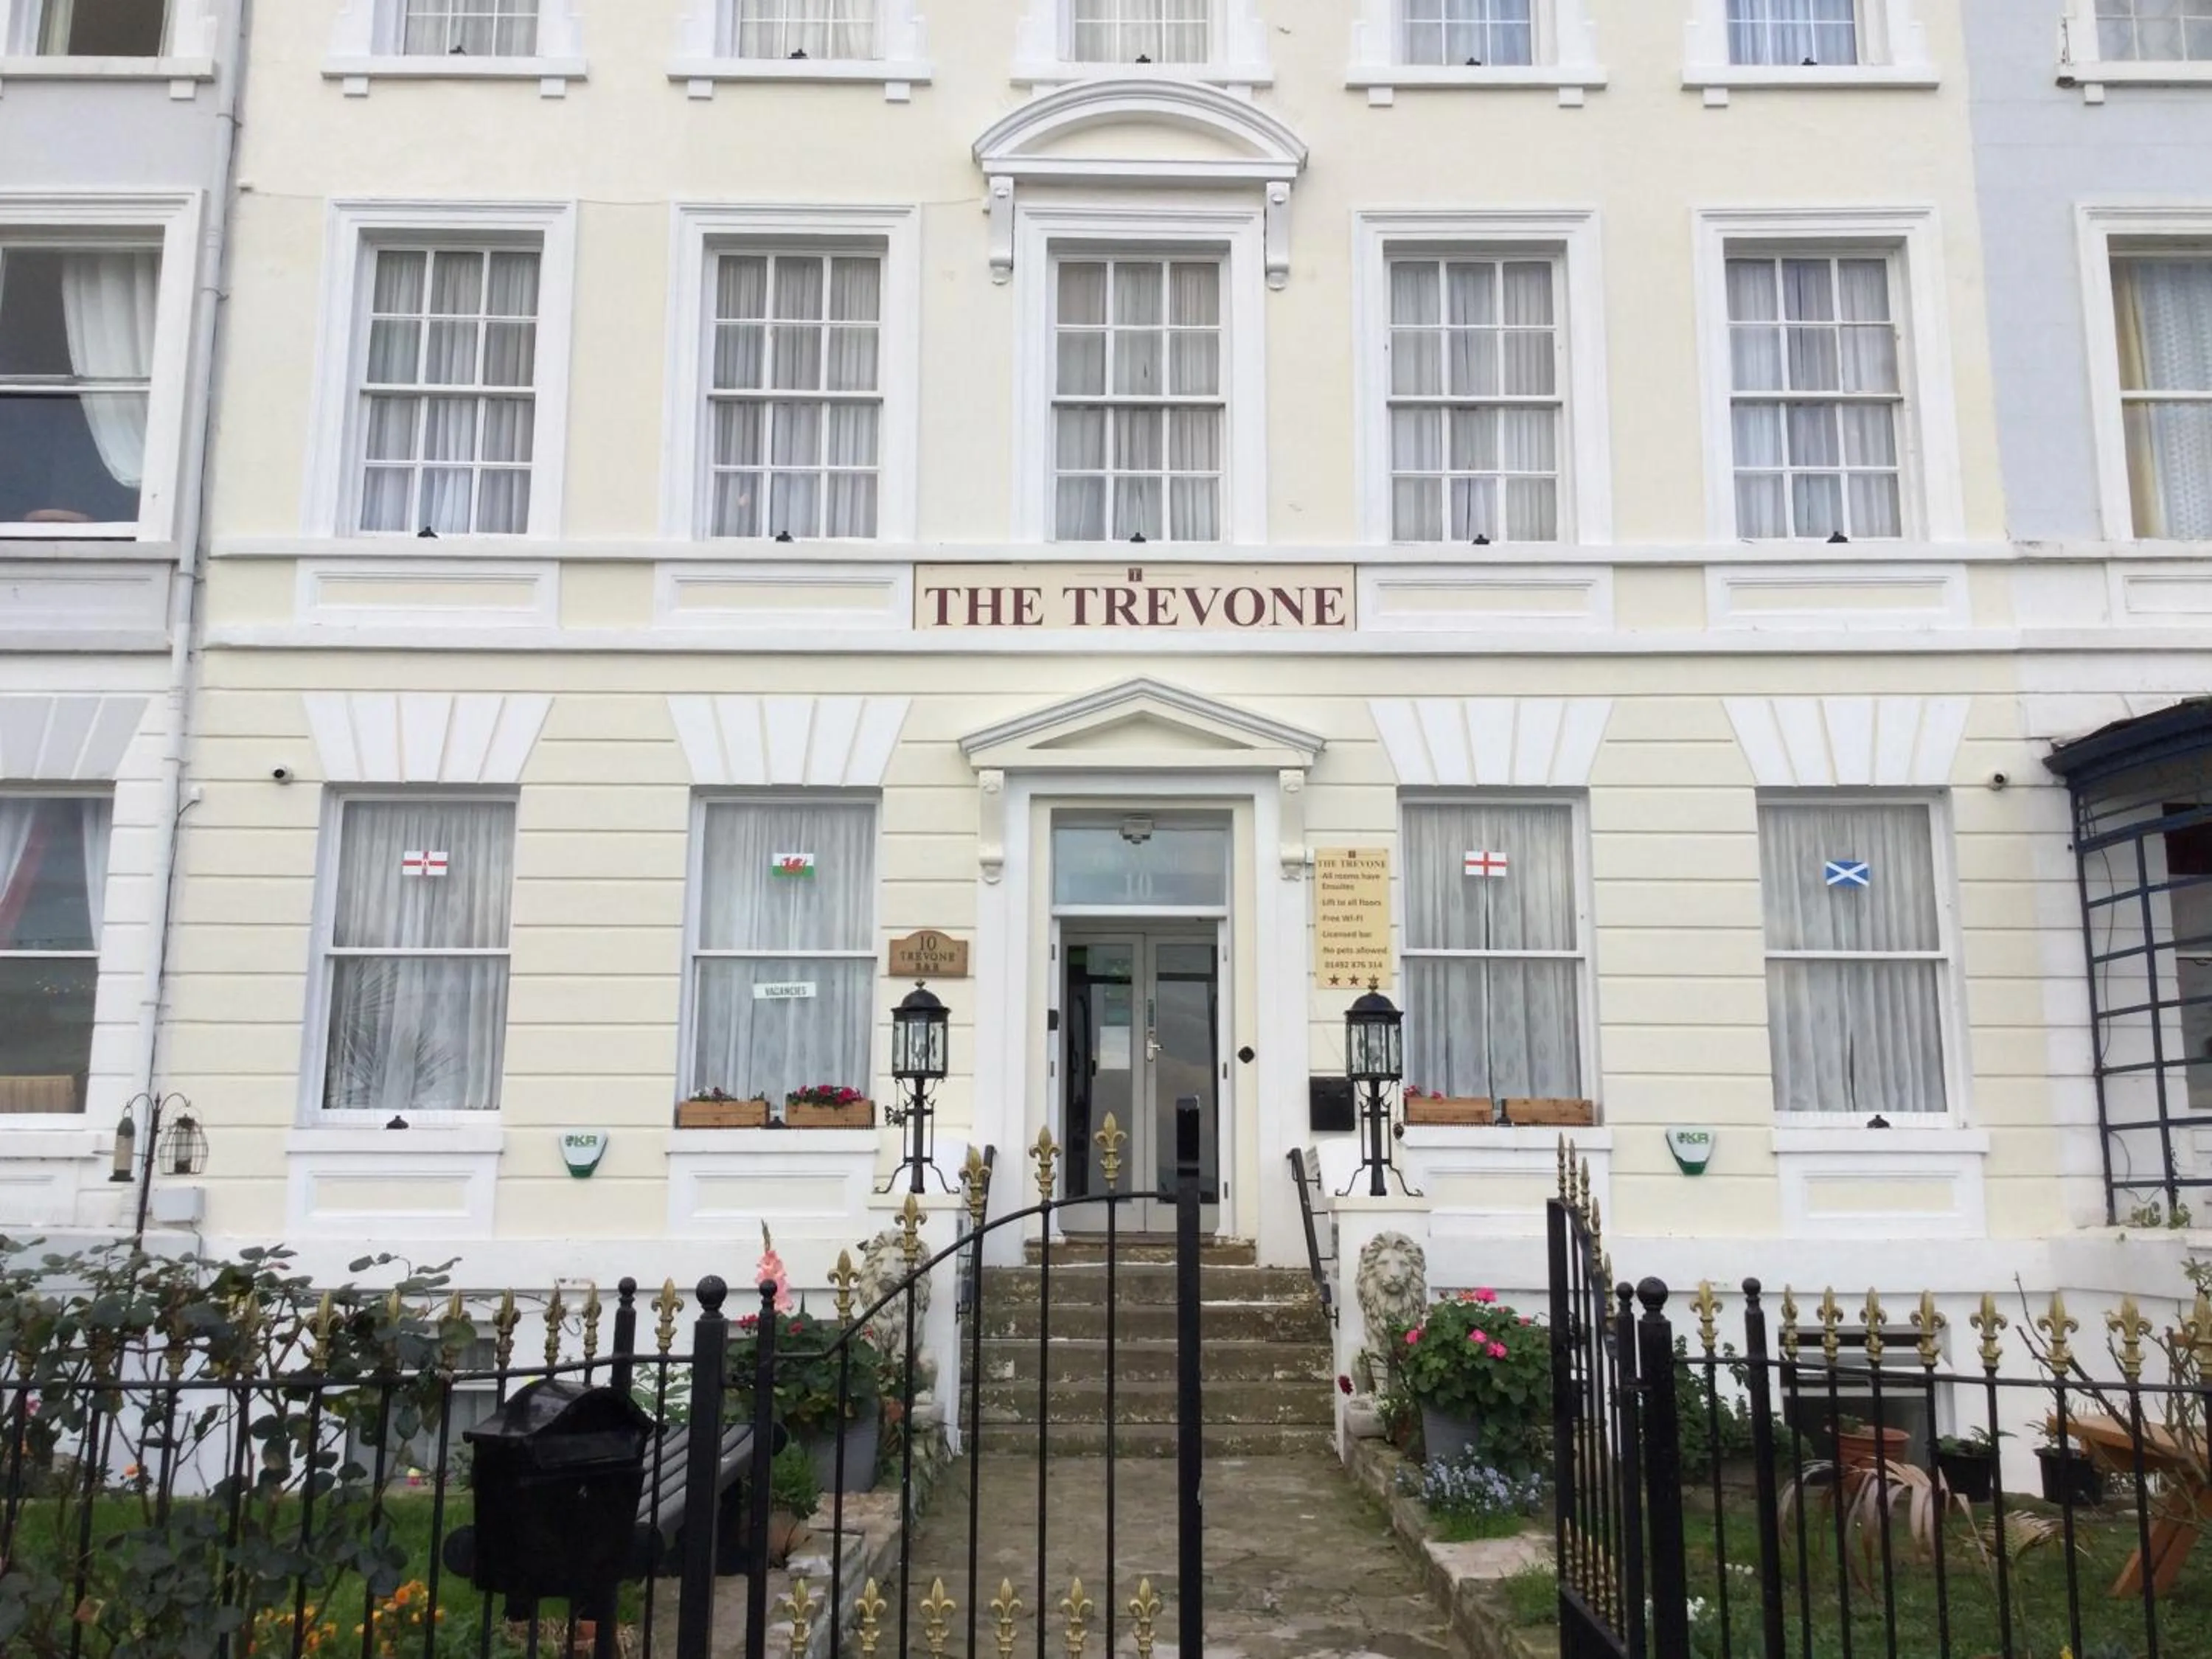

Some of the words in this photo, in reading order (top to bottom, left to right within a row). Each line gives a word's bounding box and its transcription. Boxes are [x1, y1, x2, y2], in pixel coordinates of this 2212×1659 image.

[925, 587, 1043, 626] THE
[1062, 587, 1346, 626] TREVONE
[1318, 860, 1336, 868] THE
[1340, 860, 1386, 868] TREVONE
[1362, 872, 1380, 880] have
[1125, 873, 1152, 900] 10
[1322, 898, 1335, 906] Lift
[1347, 898, 1357, 906] all
[919, 935, 936, 950] 10
[1337, 947, 1354, 955] pets
[1356, 945, 1388, 954] allowed
[900, 951, 955, 962] TREVONE
[765, 985, 807, 997] VACANCIES
